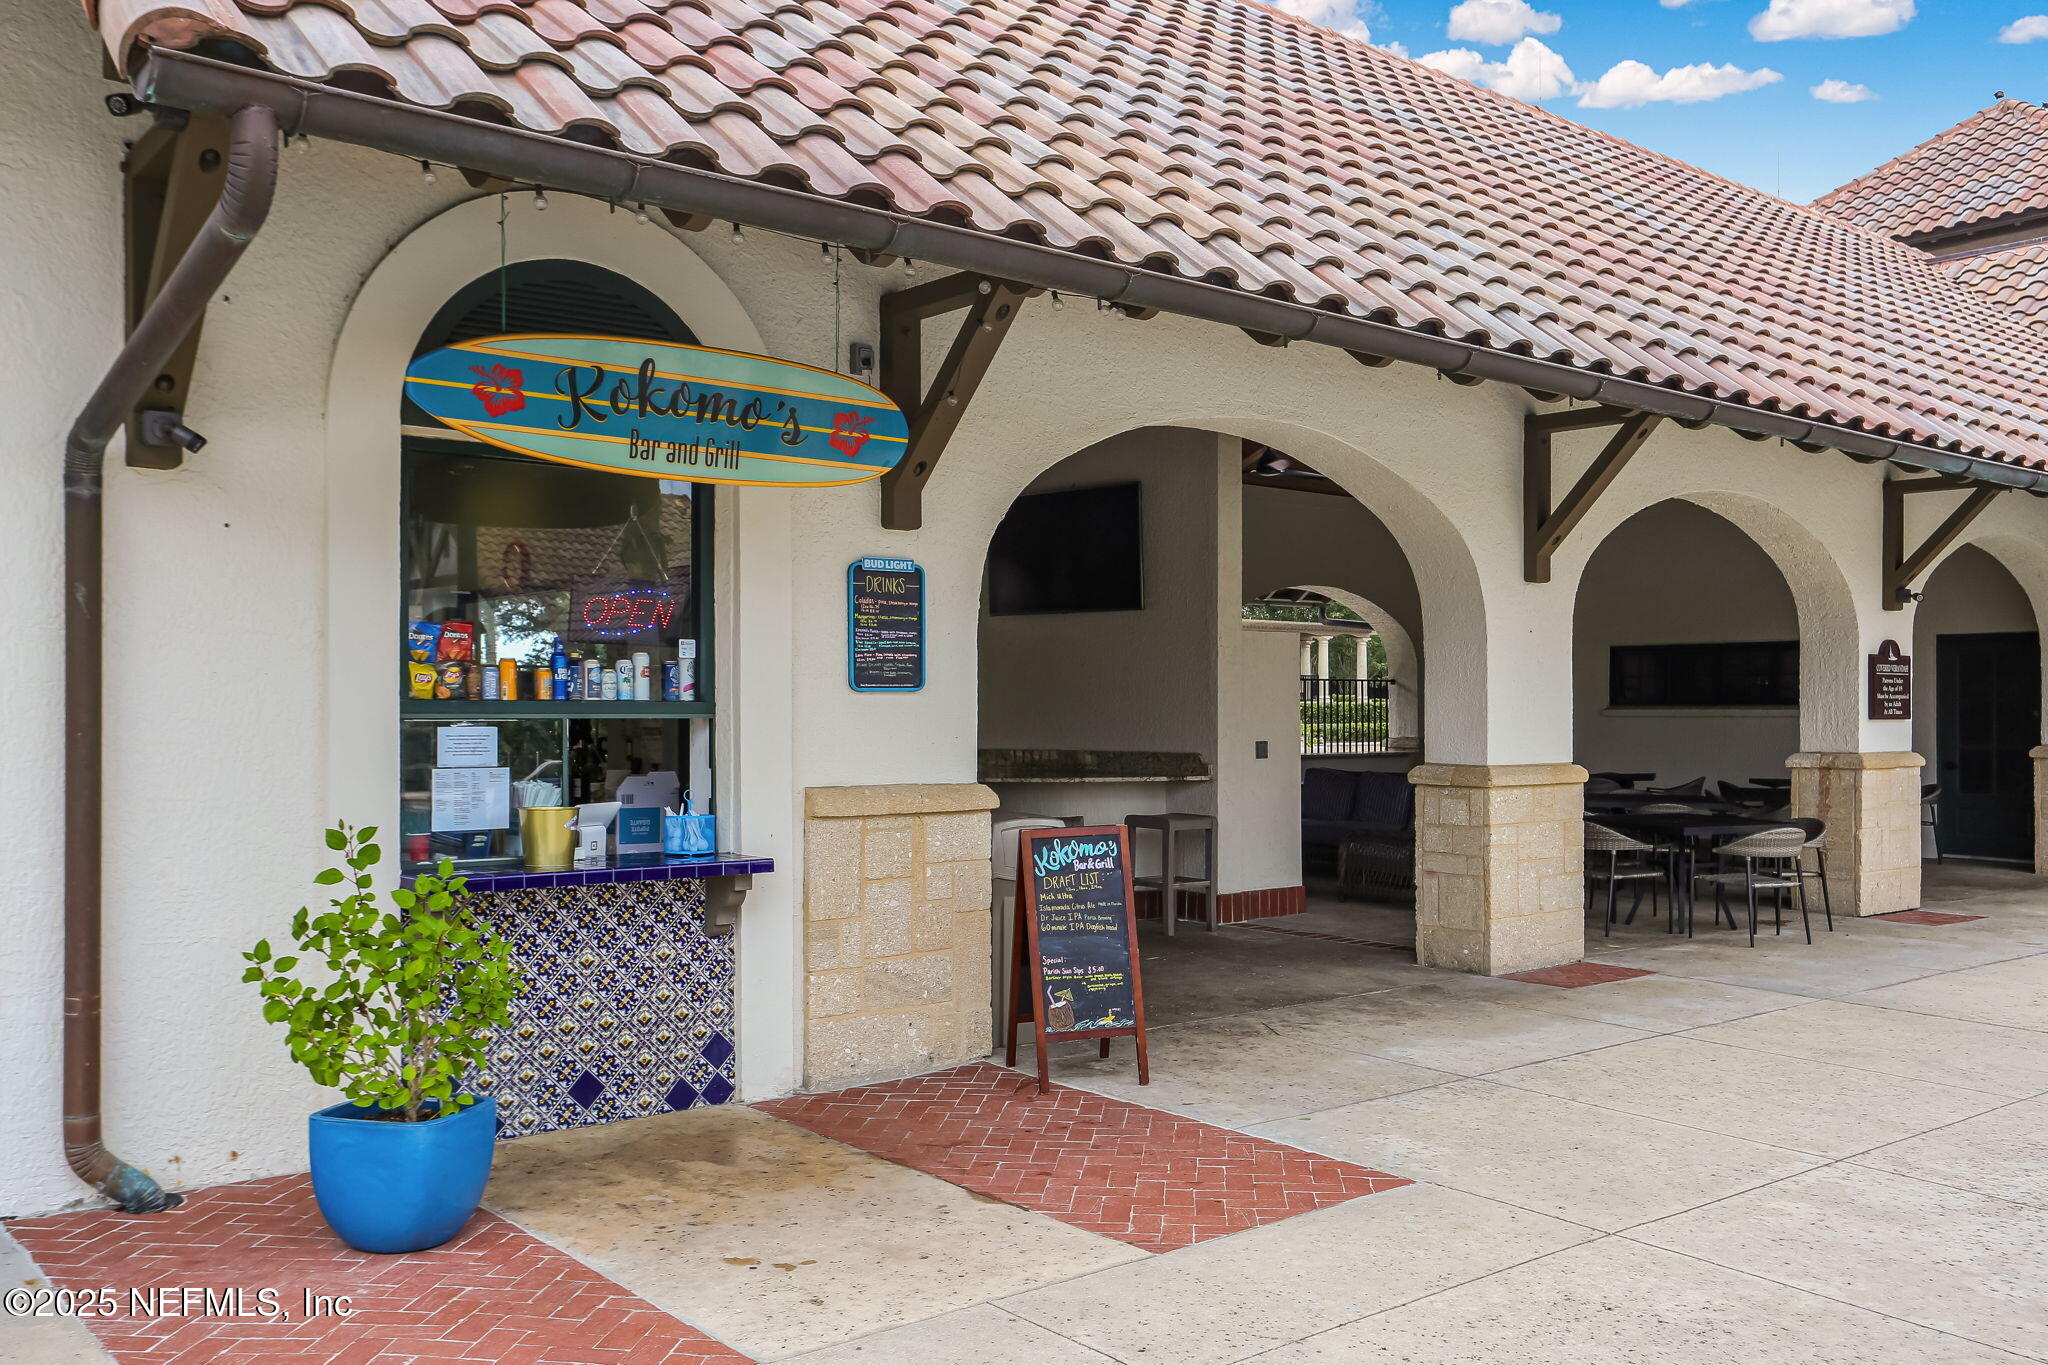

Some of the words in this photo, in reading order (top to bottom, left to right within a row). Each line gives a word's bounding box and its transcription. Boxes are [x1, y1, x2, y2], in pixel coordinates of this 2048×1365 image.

[554, 358, 808, 446] Kokomo's
[629, 429, 660, 460] Bar
[666, 436, 699, 466] and
[704, 438, 740, 470] Grill
[864, 559, 884, 568] BUD
[886, 561, 912, 570] LIGHT
[866, 576, 906, 594] DRINKS
[583, 597, 676, 629] OPEN
[1034, 838, 1118, 876] Kokomo's
[1044, 874, 1076, 890] DRAFT
[1041, 923, 1050, 931] 60
